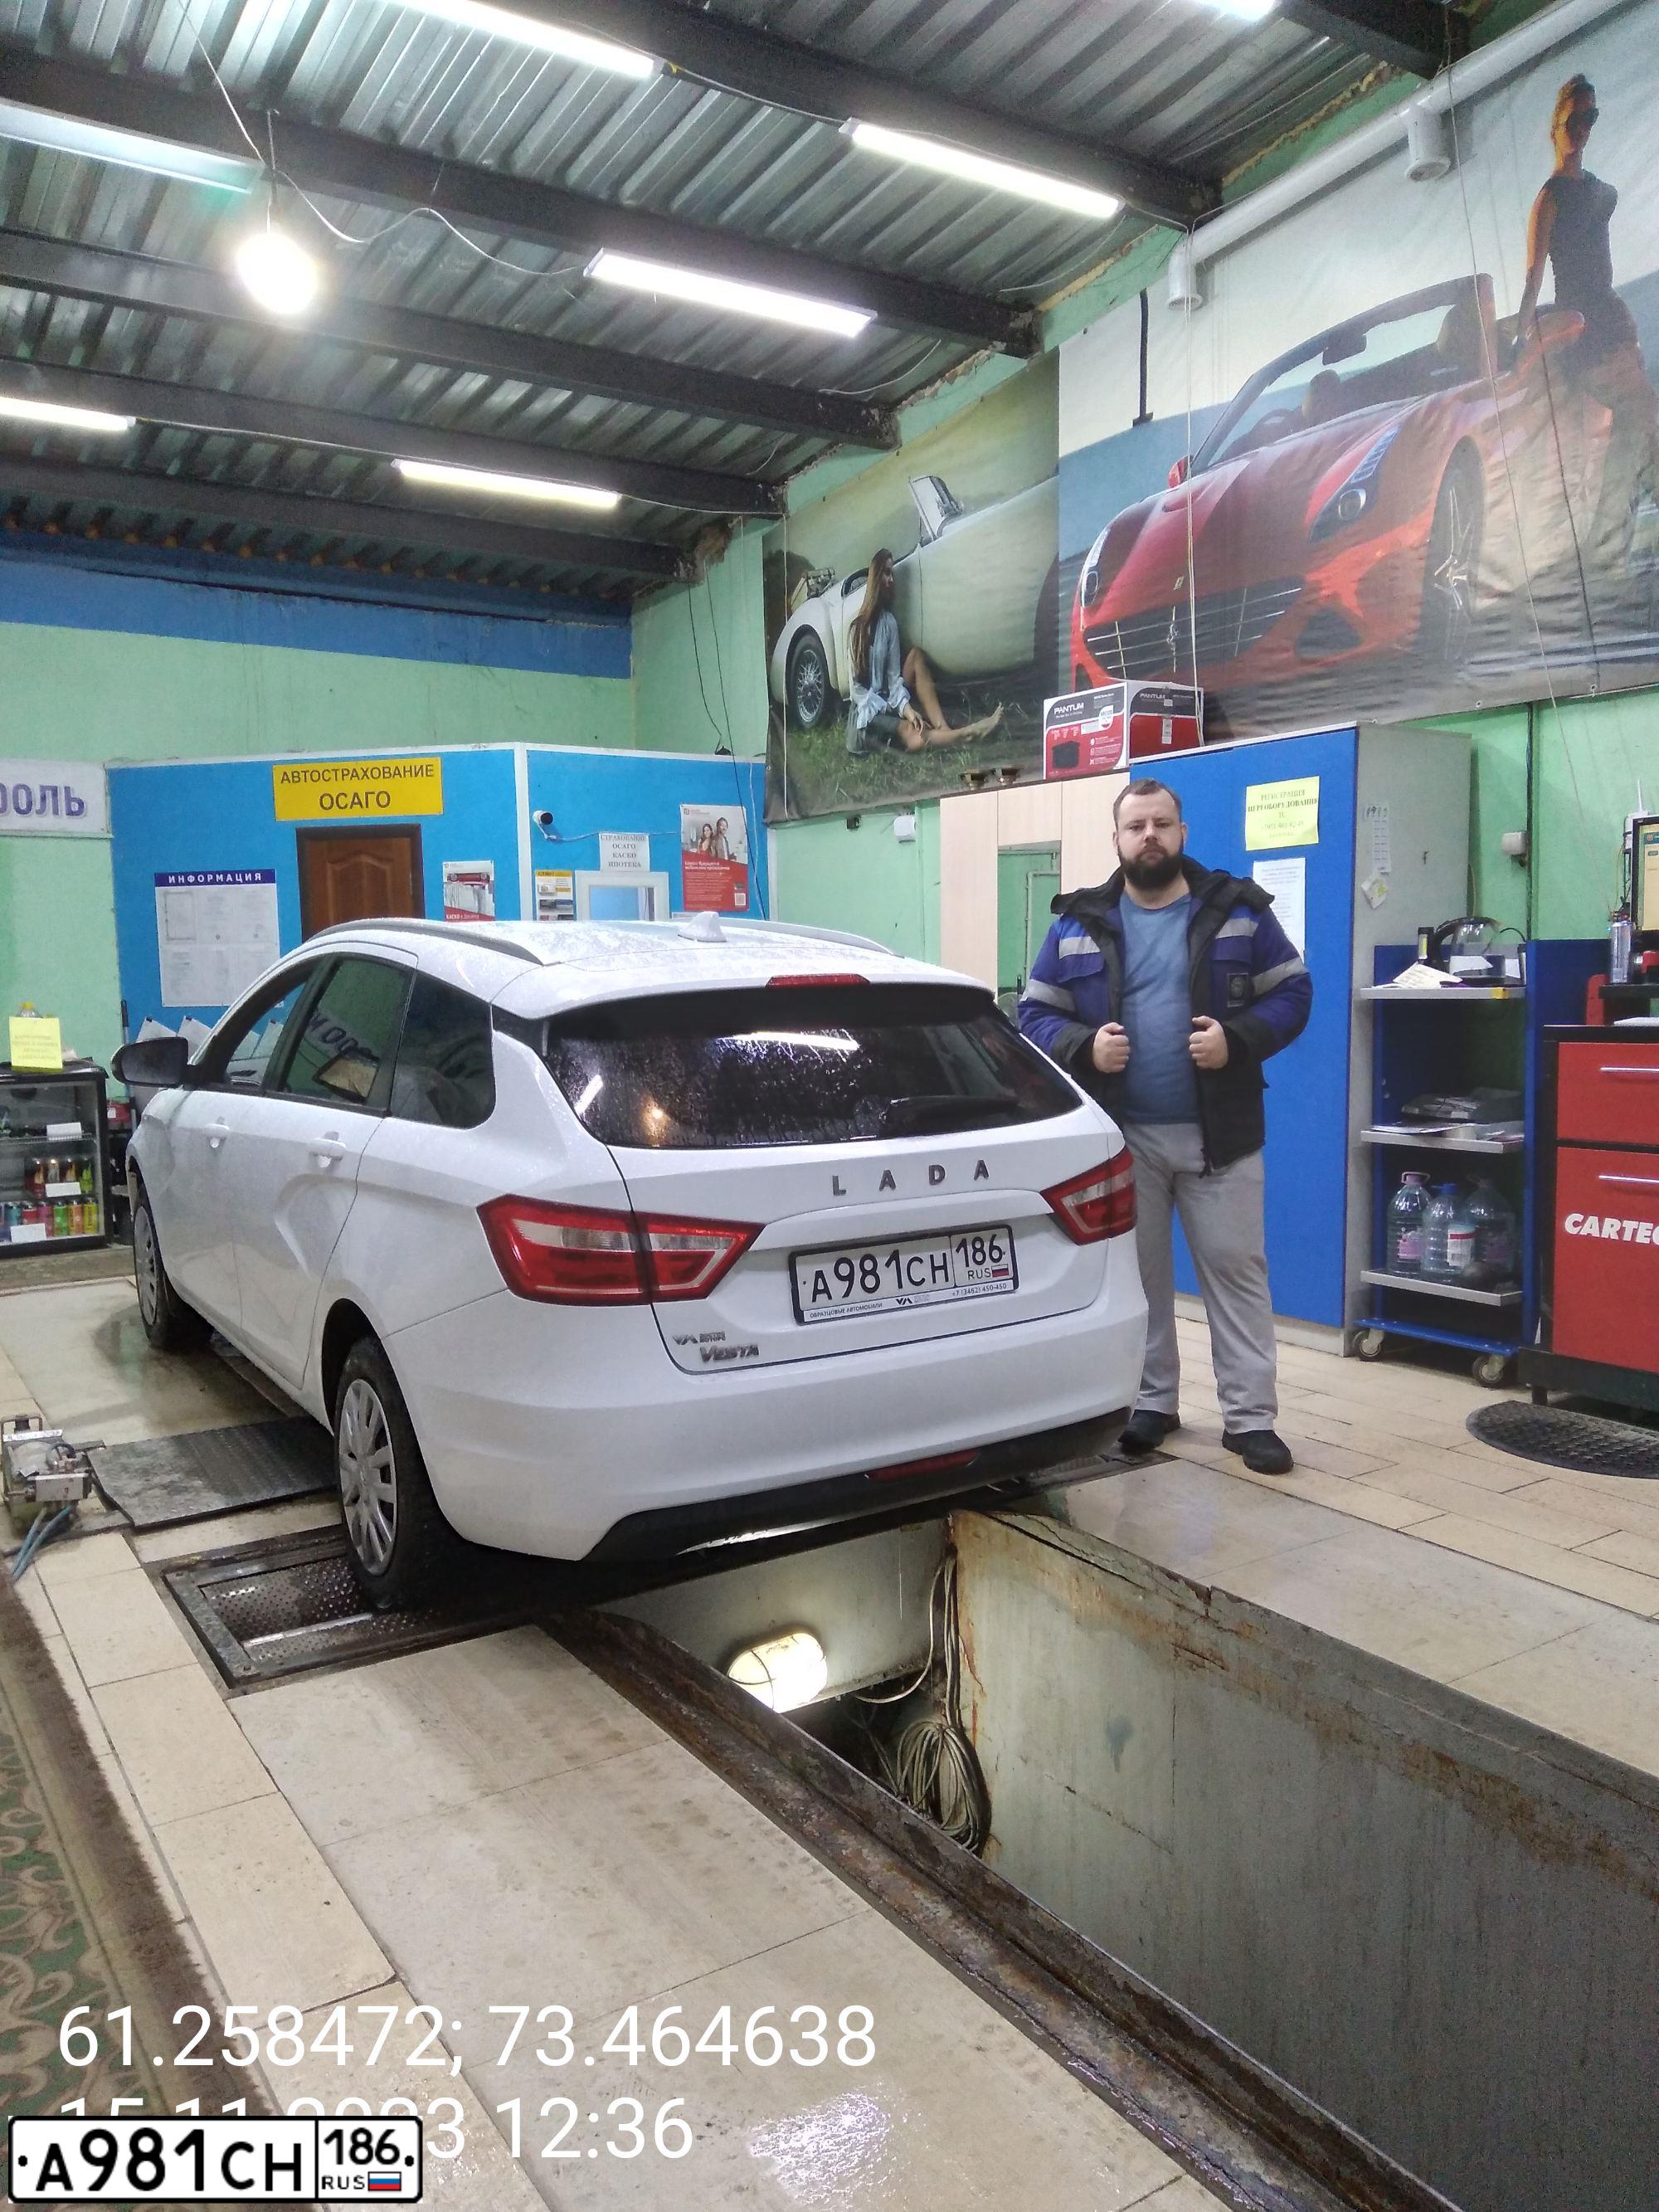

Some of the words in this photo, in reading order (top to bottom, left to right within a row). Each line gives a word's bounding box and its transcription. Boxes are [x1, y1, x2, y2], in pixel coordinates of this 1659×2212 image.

[1053, 702, 1084, 714] PANTUM
[280, 763, 434, 784] АВТОСТРАХОВАНИЕ
[319, 790, 391, 811] ОСАГО
[168, 872, 262, 884] ИНФОРМАЦИЯ
[832, 1159, 990, 1196] LADA
[811, 1249, 949, 1303] А981СН
[955, 1234, 1003, 1268] 186
[968, 1268, 991, 1281] RUS
